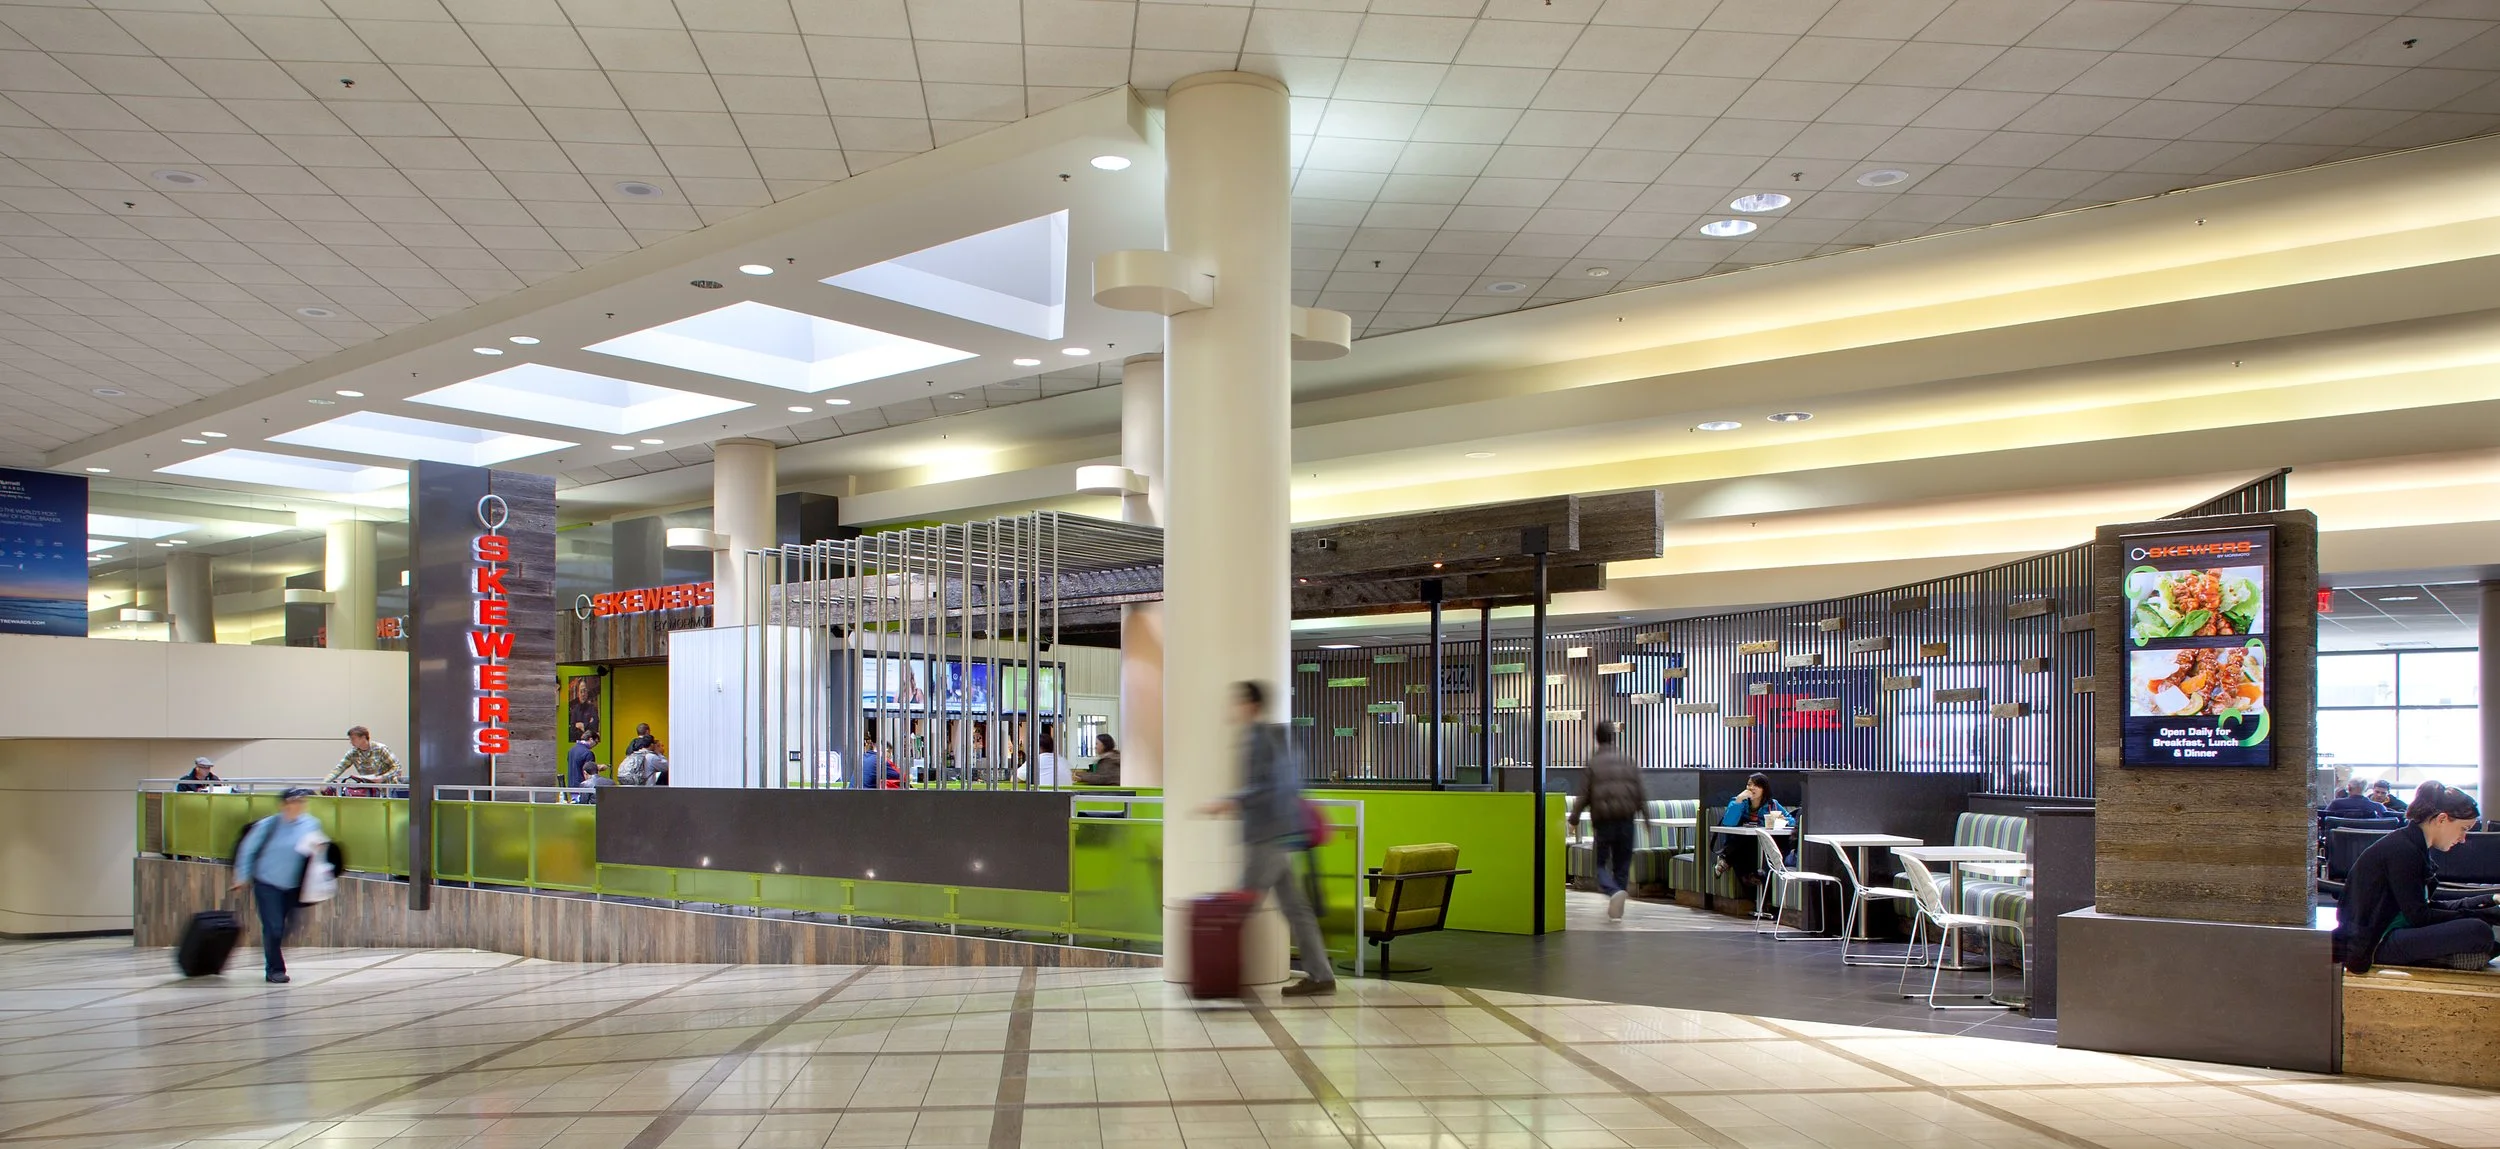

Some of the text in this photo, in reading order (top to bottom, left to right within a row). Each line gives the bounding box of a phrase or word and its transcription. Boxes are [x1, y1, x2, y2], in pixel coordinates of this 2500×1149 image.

[2149, 541, 2251, 557] SKEWERS
[593, 582, 714, 617] SKEWERS
[655, 615, 713, 631] BY MORIMOT
[471, 535, 515, 754] SKEWERS
[2160, 727, 2231, 737] Open Daily for
[2153, 738, 2239, 747] Breakfast, Lunch
[2173, 749, 2218, 757] & Dinner
